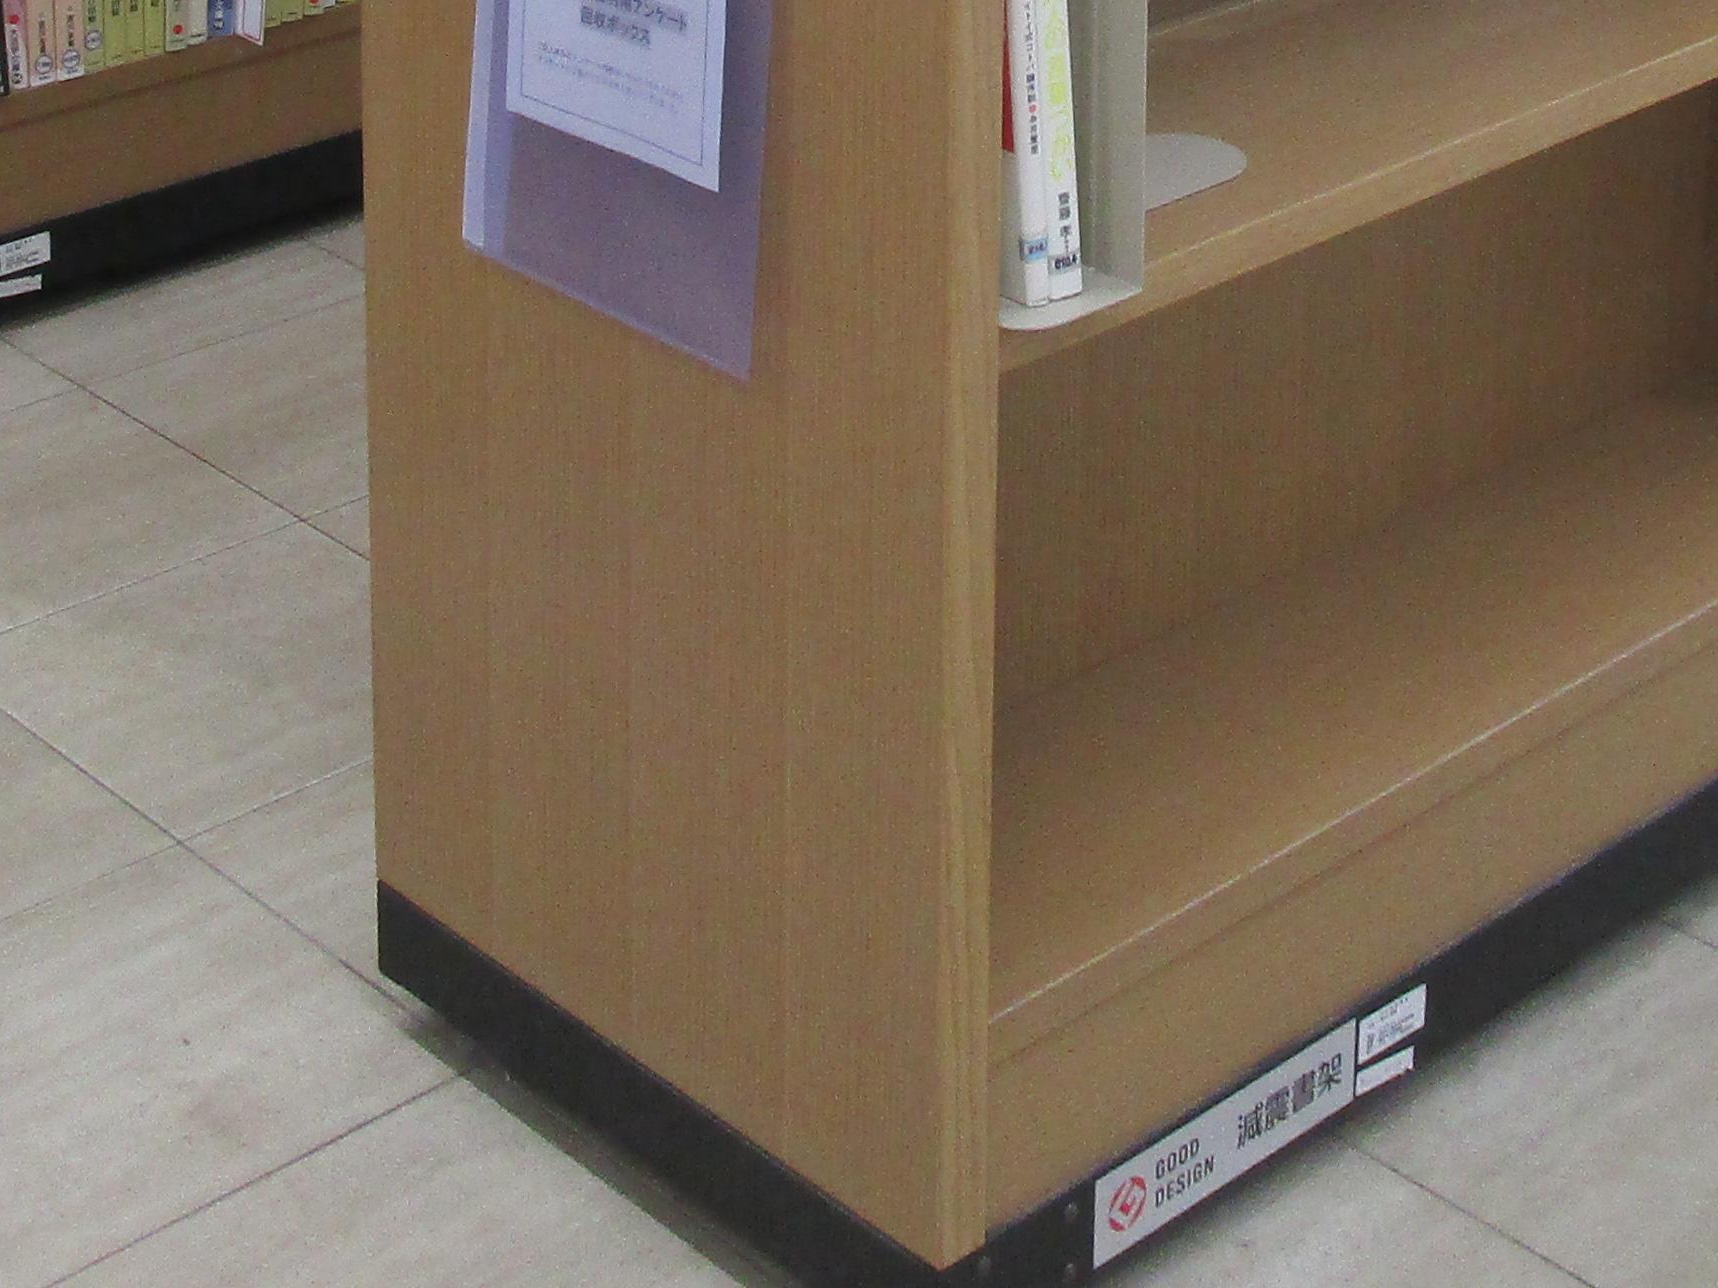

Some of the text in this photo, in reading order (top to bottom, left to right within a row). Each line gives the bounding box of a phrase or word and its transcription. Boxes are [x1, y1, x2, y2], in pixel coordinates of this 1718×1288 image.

[581, 6, 651, 45] 回収ボックス
[1236, 1052, 1343, 1151] 減震書架
[1155, 1136, 1201, 1181] GOOD
[1155, 1154, 1215, 1208] DESIGN
